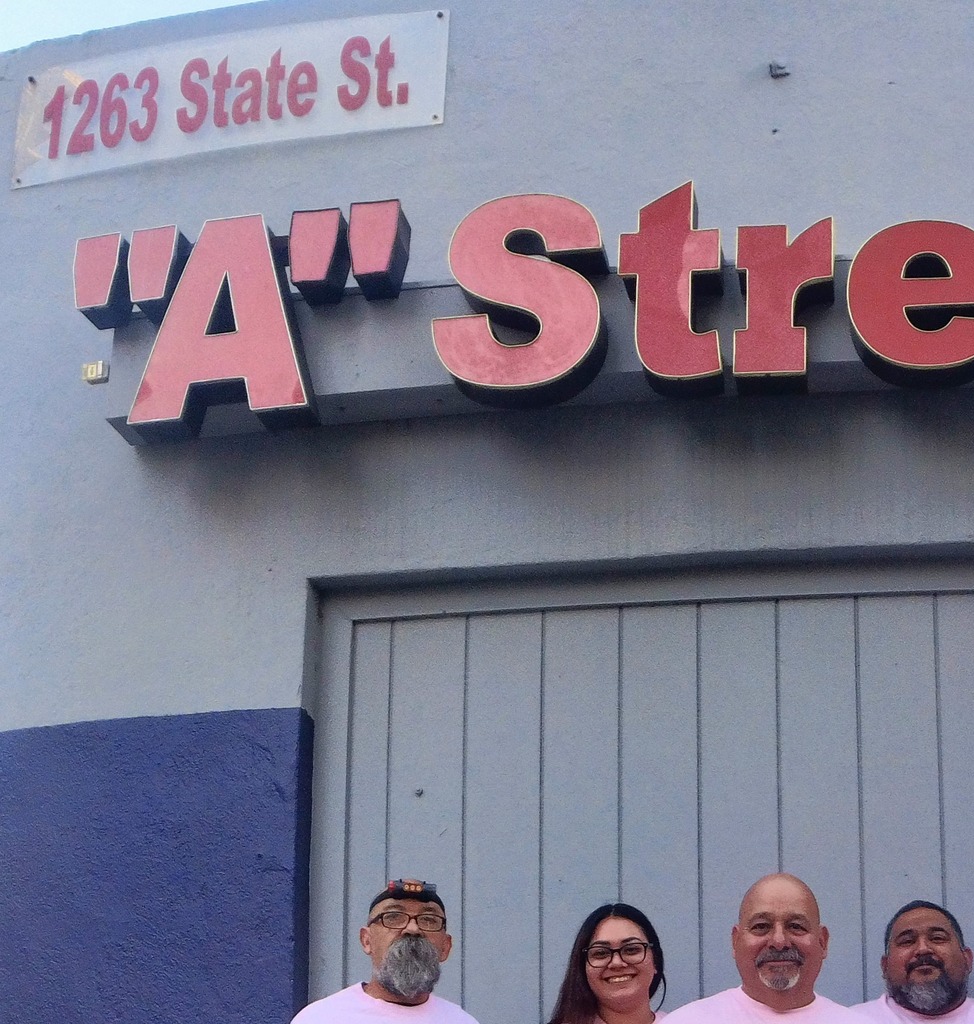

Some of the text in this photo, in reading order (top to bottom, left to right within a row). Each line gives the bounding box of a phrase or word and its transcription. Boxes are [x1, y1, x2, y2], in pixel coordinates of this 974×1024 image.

[42, 35, 410, 160] 1263 State St.
[73, 199, 405, 426] "A"
